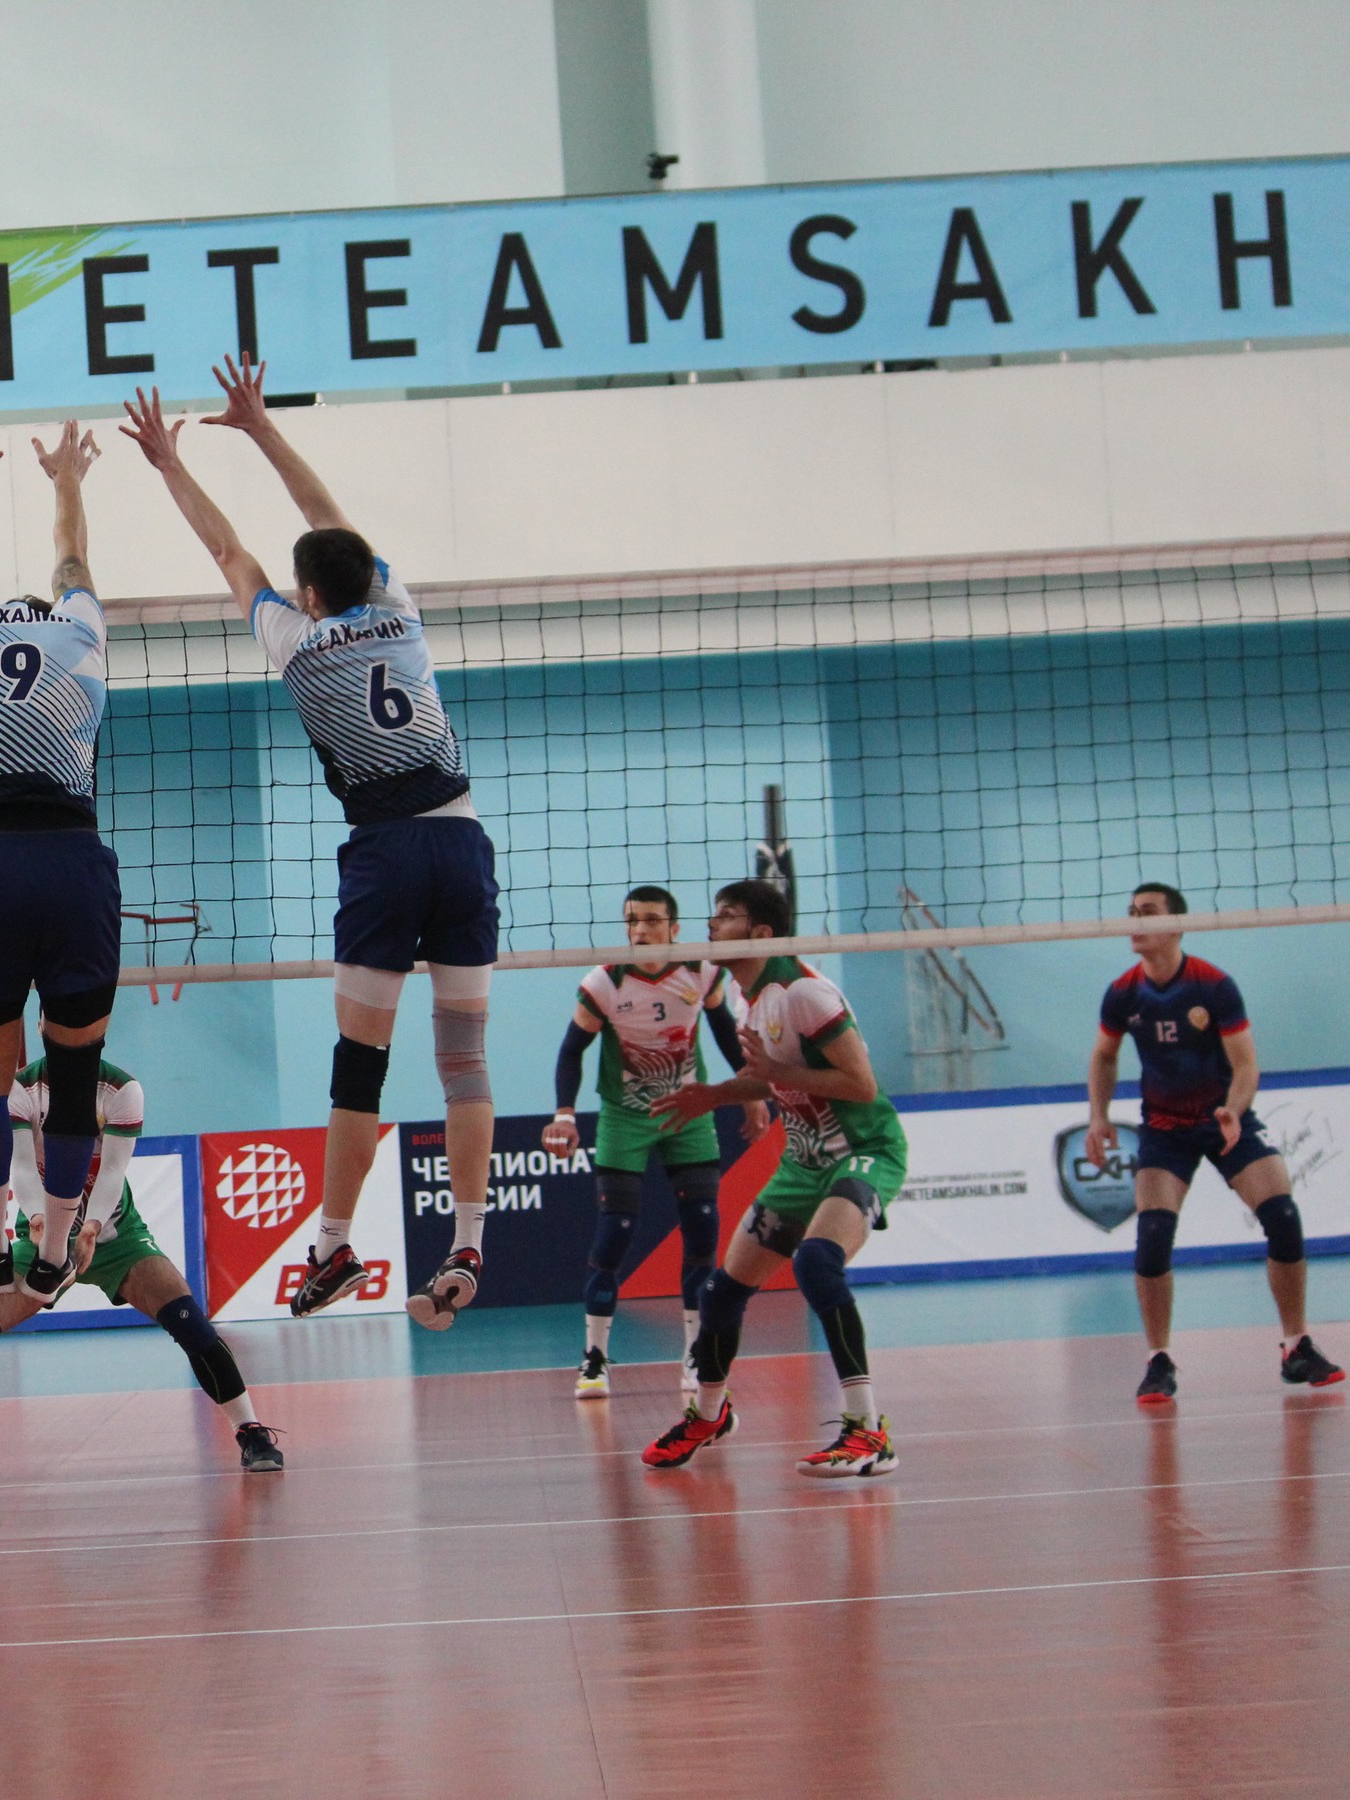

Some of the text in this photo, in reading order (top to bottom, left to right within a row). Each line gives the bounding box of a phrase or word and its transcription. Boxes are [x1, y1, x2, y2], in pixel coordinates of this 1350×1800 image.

[0, 643, 42, 701] 9
[370, 663, 414, 730] 6
[652, 1002, 666, 1022] 3
[1155, 1020, 1179, 1043] 12
[411, 1147, 597, 1182] ЧЕПИОНА
[273, 1258, 392, 1306] ВВ
